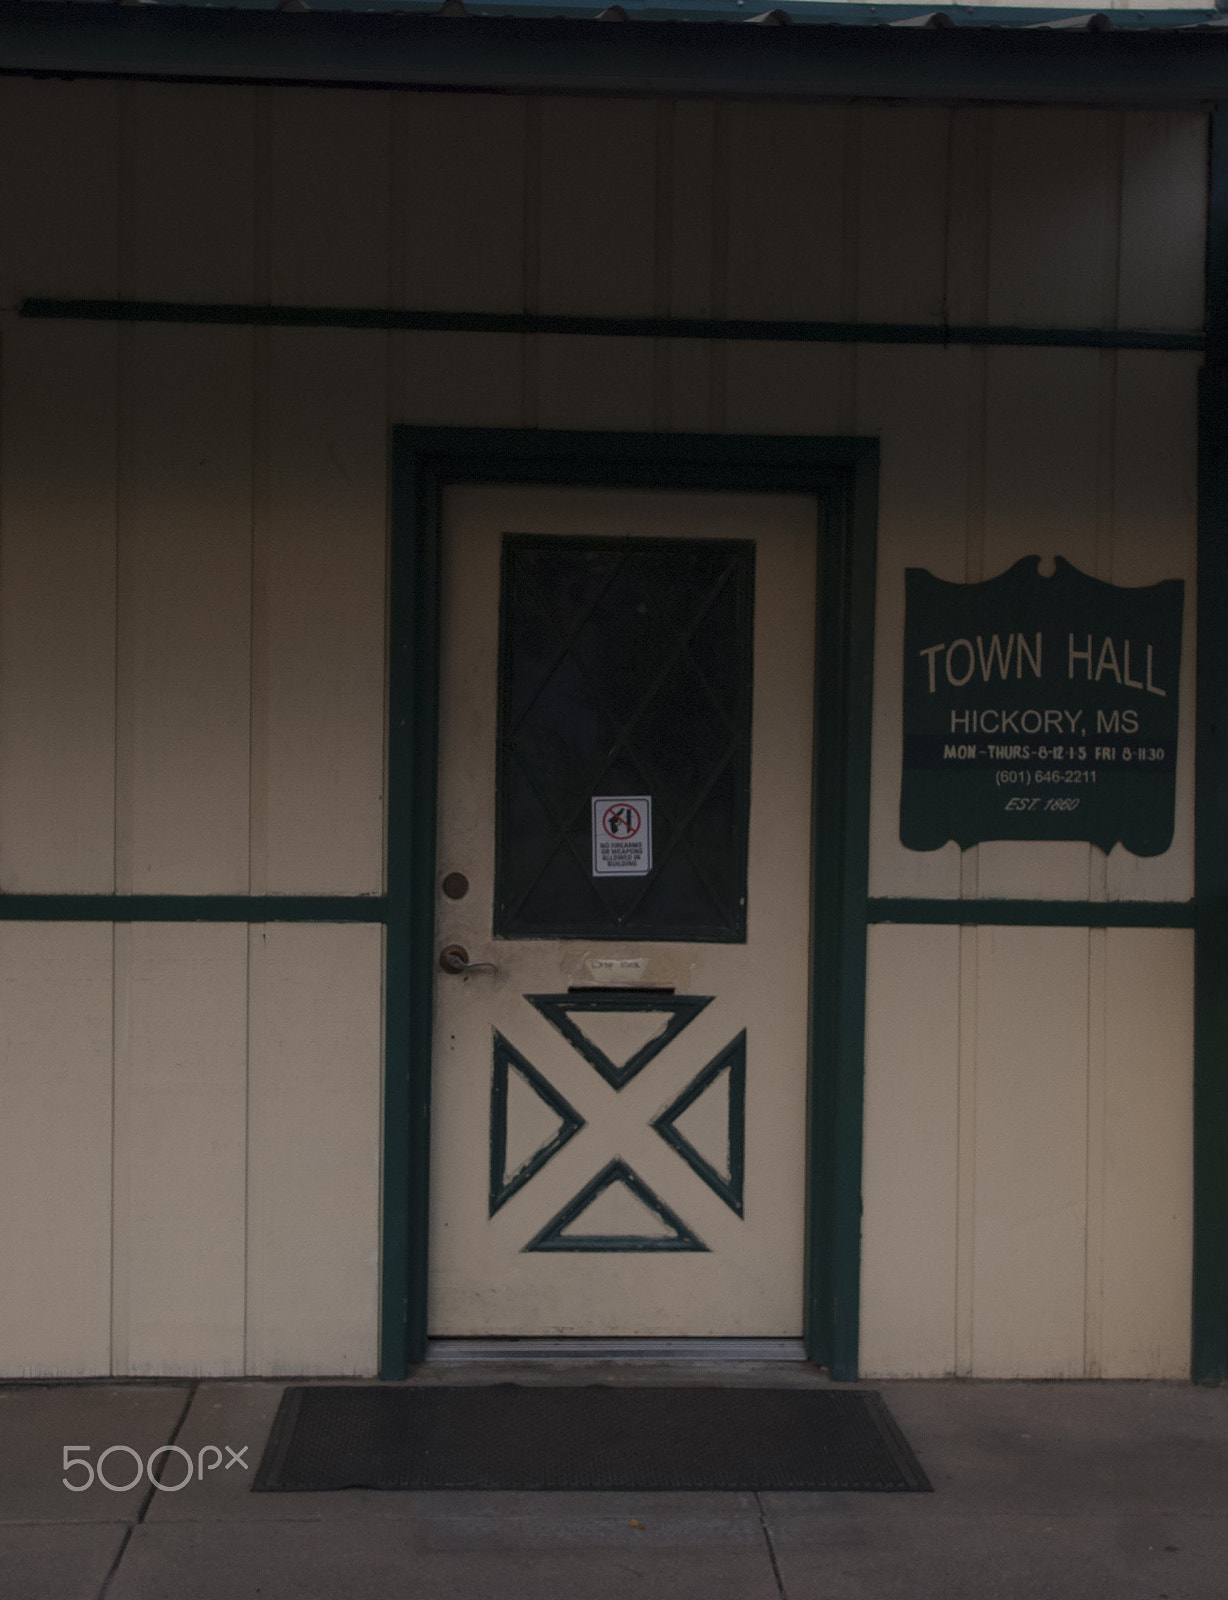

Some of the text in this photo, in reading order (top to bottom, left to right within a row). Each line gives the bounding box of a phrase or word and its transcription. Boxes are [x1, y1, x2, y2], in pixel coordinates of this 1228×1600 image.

[919, 632, 1167, 697] TOWN HALL
[951, 709, 1139, 738] HICKORY, MS
[1095, 746, 1116, 761] FRI
[995, 770, 1097, 787] (601) 646-2211
